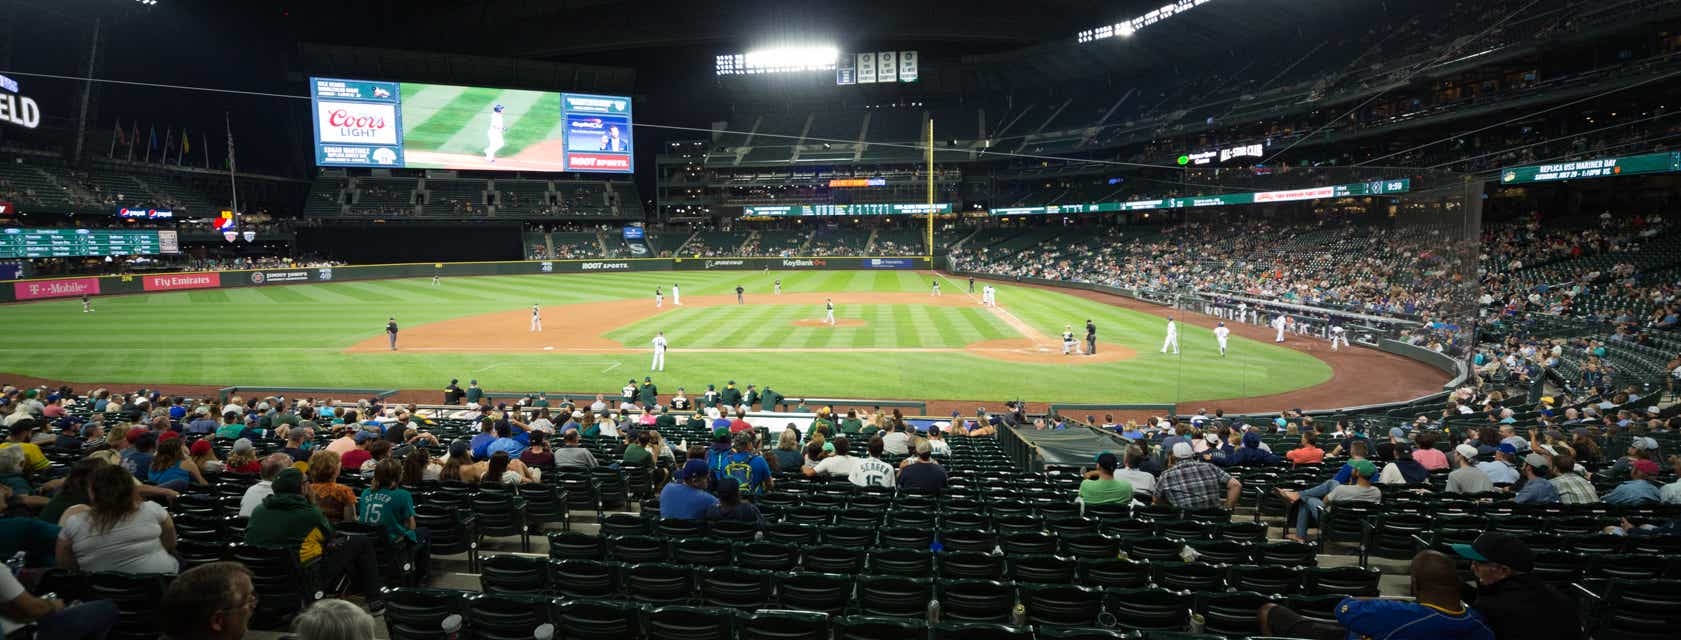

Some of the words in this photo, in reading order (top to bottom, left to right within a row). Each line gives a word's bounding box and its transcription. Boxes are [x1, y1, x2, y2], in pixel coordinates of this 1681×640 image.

[328, 108, 385, 129] Coors
[341, 128, 377, 138] LIGHT
[1540, 164, 1564, 173] REPLICA
[1564, 163, 1576, 171] USS
[1576, 160, 1603, 170] MARINER
[1603, 159, 1617, 167] DAY
[582, 262, 602, 270] ROOT
[783, 259, 814, 267] KeyBank
[154, 276, 171, 287] Fly
[172, 275, 210, 286] Emirates
[861, 462, 890, 476] SEAGER
[364, 493, 392, 504] SEAGER
[364, 503, 384, 523] 15
